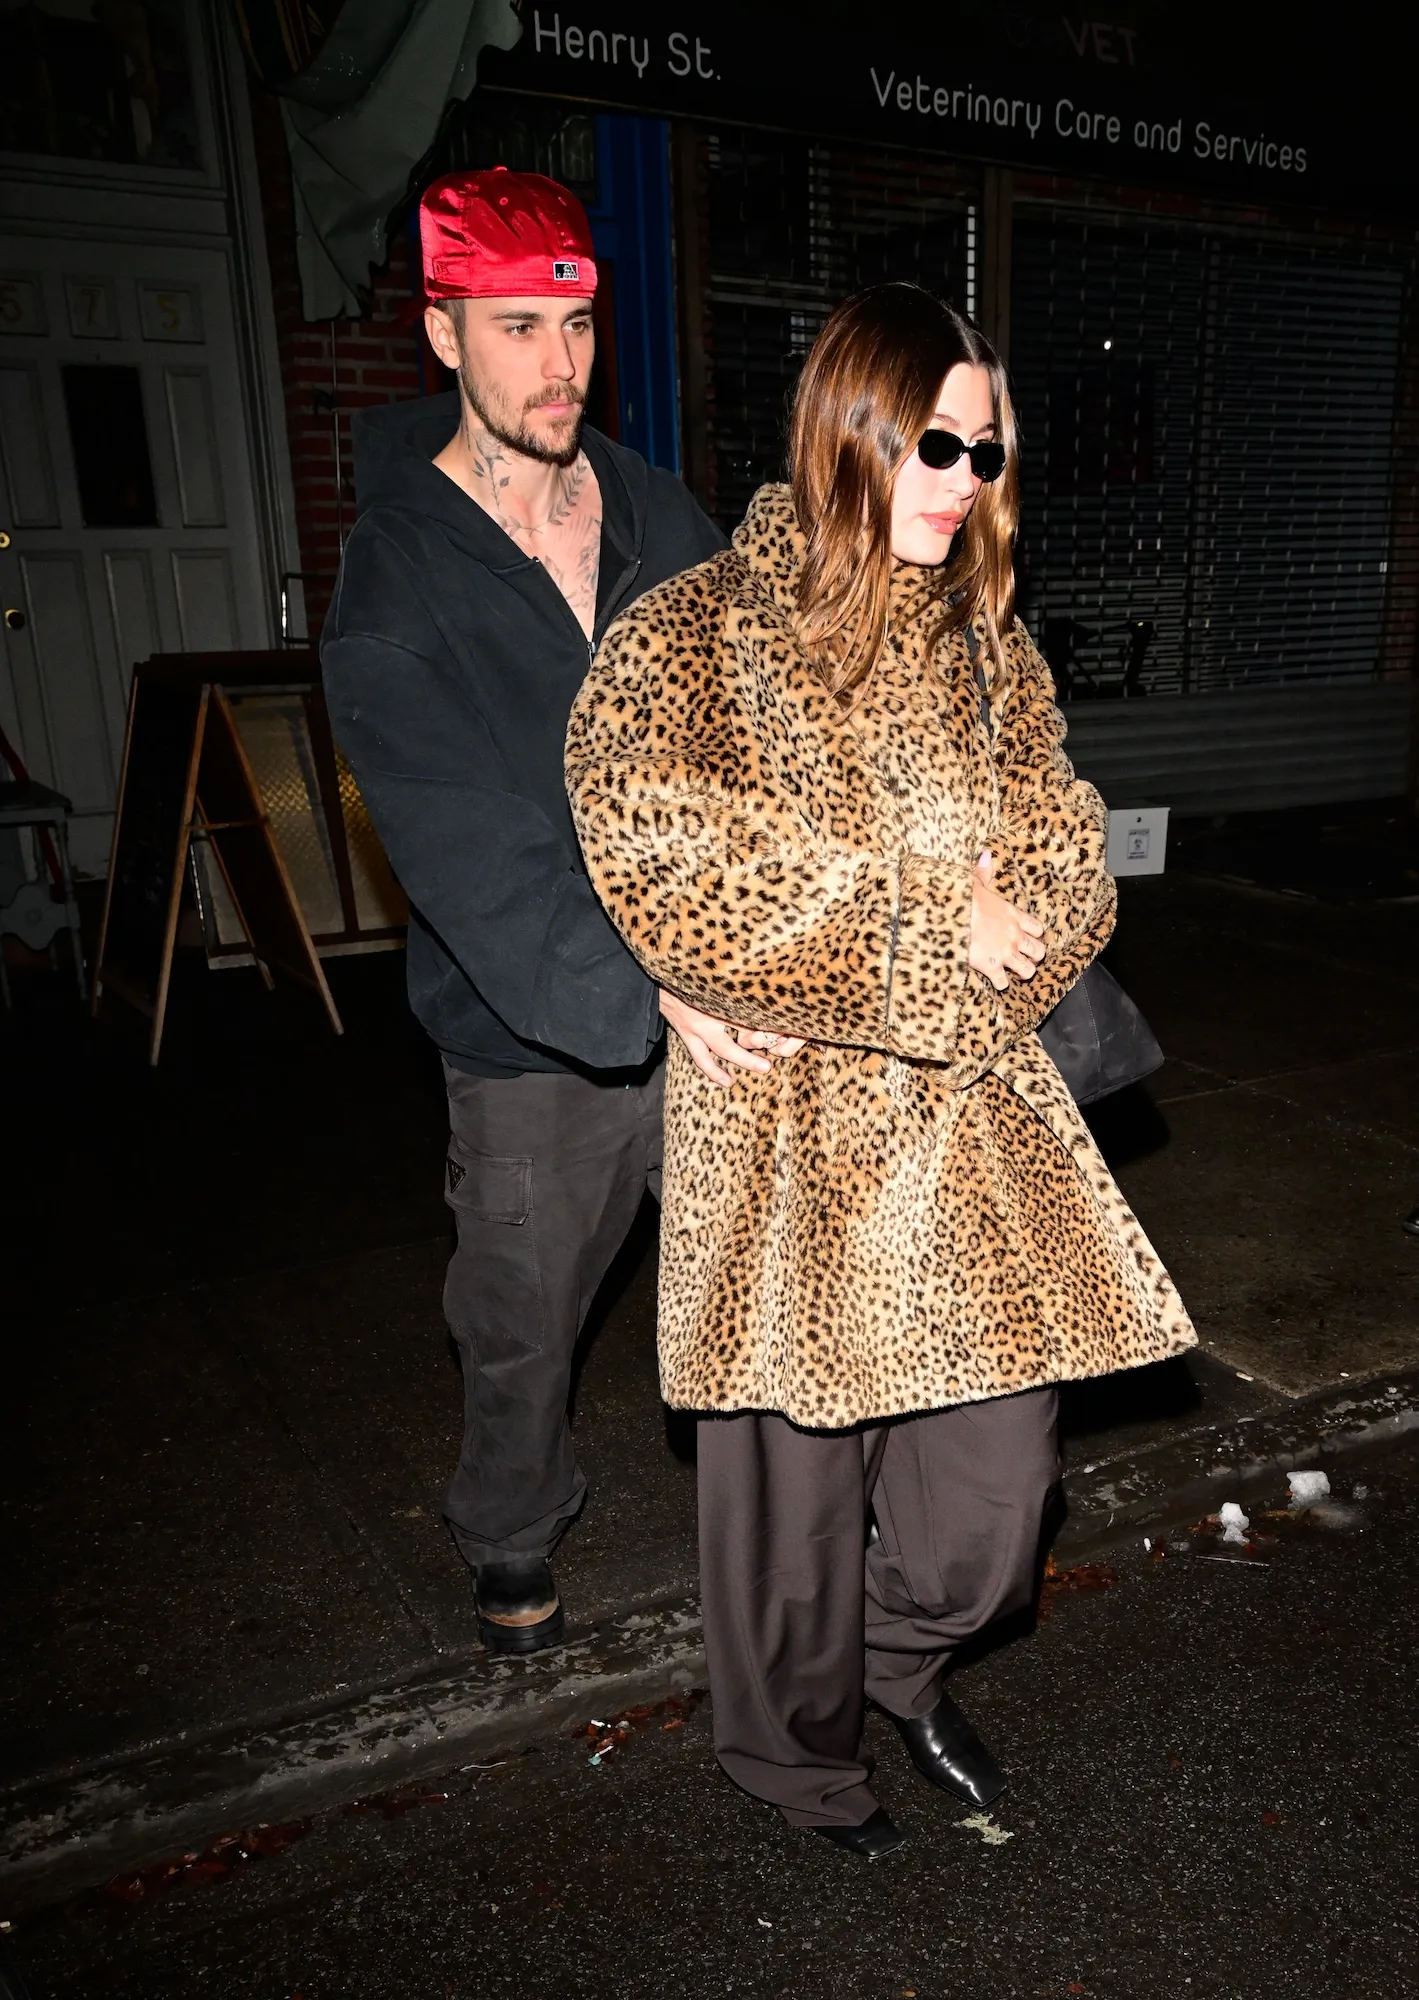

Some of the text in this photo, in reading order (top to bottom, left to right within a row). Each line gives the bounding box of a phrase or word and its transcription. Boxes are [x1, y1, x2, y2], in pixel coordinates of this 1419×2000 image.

[534, 9, 721, 80] Henry St.
[1061, 15, 1138, 67] VET
[870, 67, 1308, 173] Veterinary Care and Services
